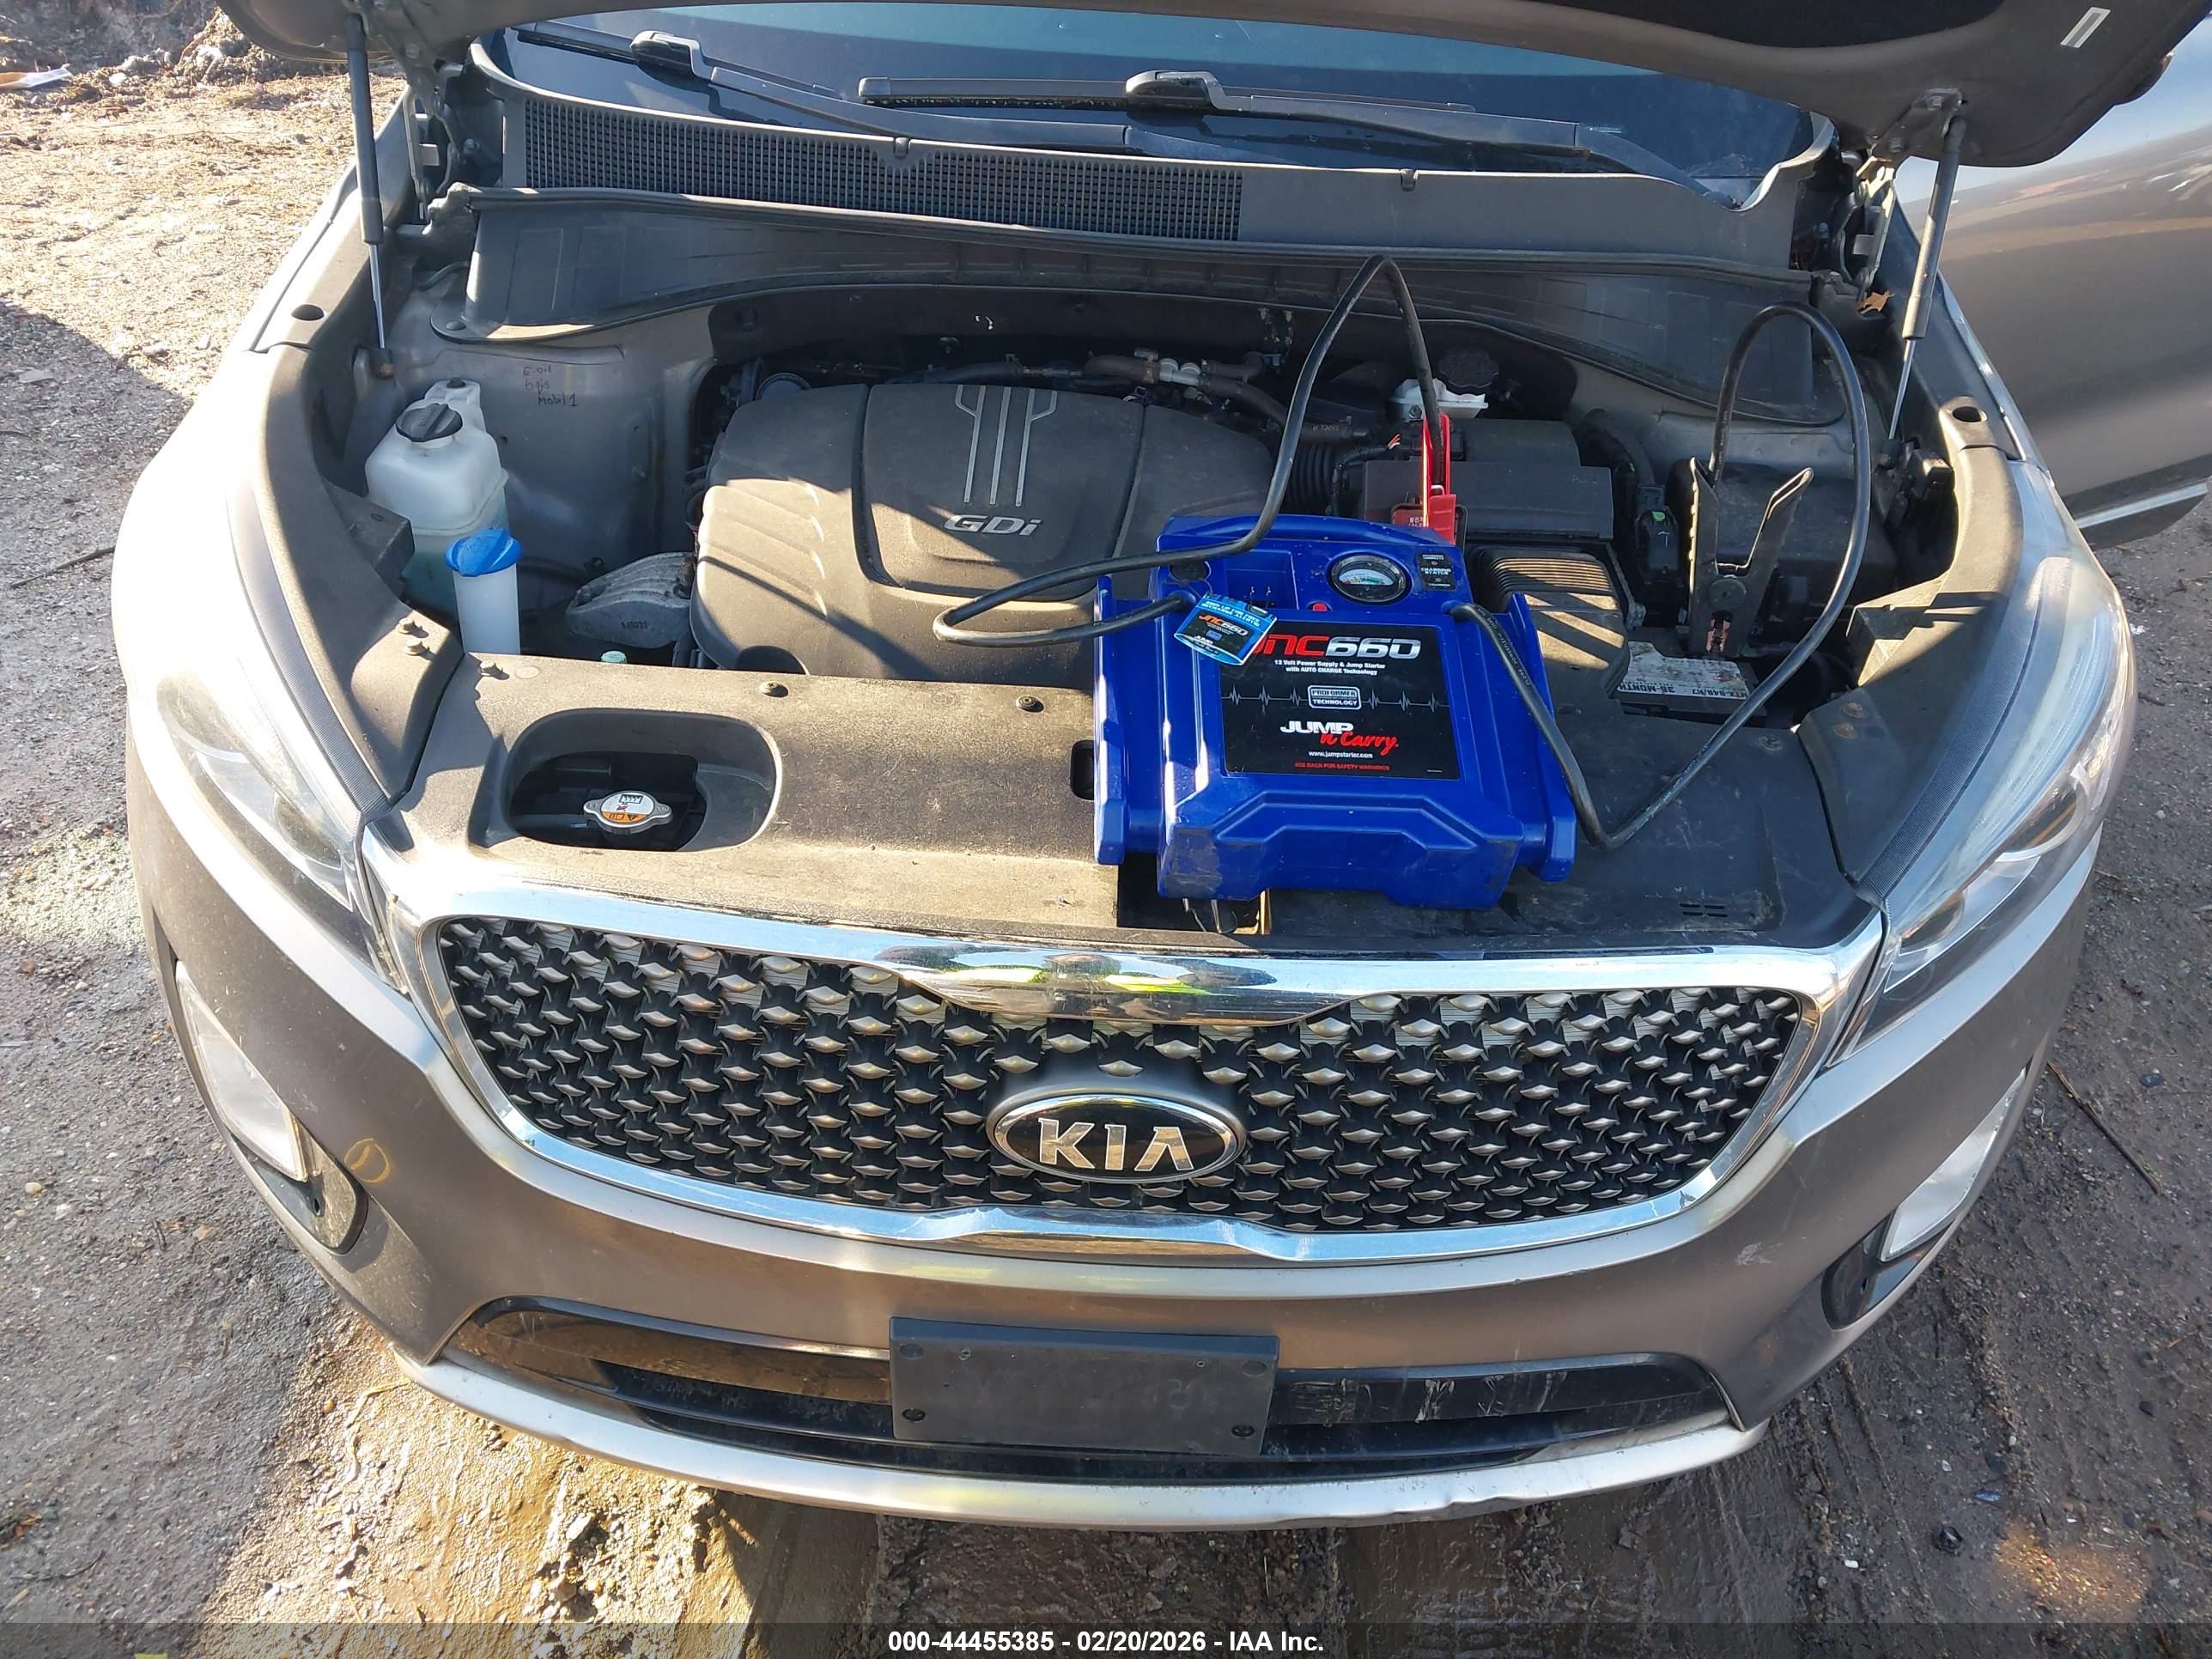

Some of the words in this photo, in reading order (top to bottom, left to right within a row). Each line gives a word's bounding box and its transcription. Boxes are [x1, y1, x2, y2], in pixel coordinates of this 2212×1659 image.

[569, 392, 578, 407] 1
[944, 514, 1042, 536] GDi
[1199, 615, 1249, 636] JNC660
[1279, 720, 1354, 735] JUMP
[1308, 750, 1373, 759] www.jumpstarter.com
[1038, 1117, 1194, 1172] KIA
